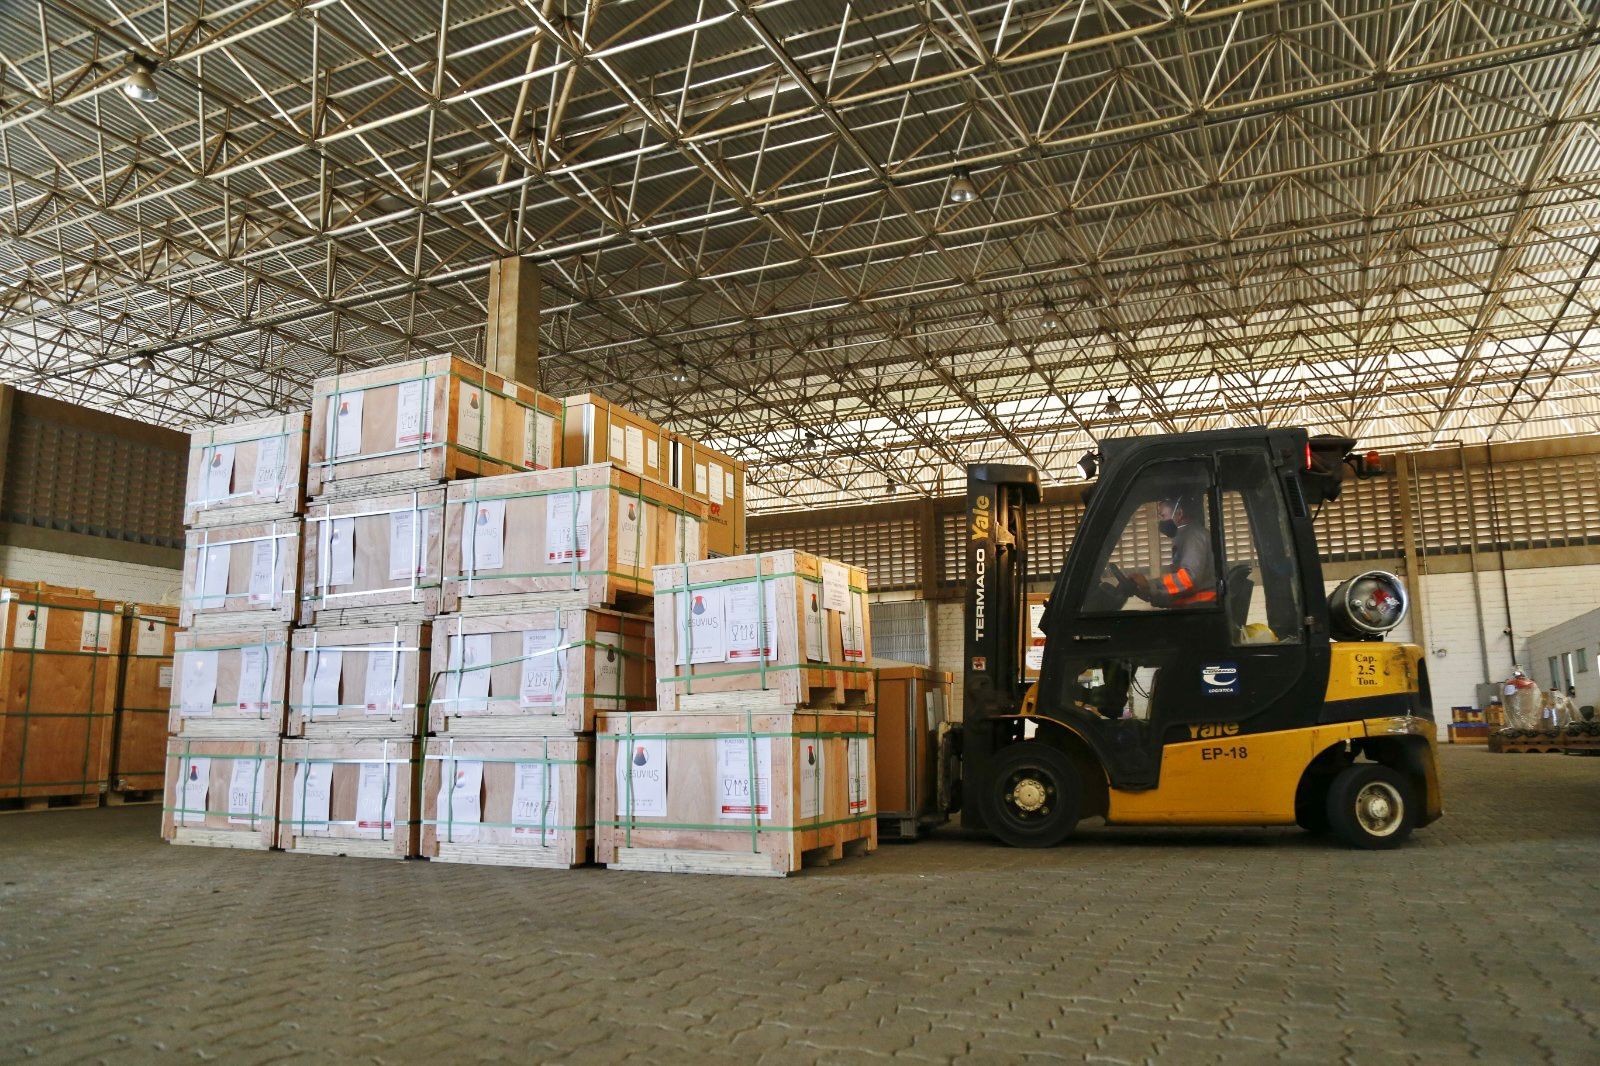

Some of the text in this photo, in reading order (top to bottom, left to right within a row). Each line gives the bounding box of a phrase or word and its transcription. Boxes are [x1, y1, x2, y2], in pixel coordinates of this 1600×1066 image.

[971, 495, 990, 541] Yale
[975, 548, 986, 642] TERMACO
[1354, 652, 1377, 663] Cap.
[1357, 665, 1376, 675] 2.5
[1356, 677, 1378, 686] Ton.
[1188, 722, 1240, 739] Yale
[1202, 746, 1248, 761] EP-18
